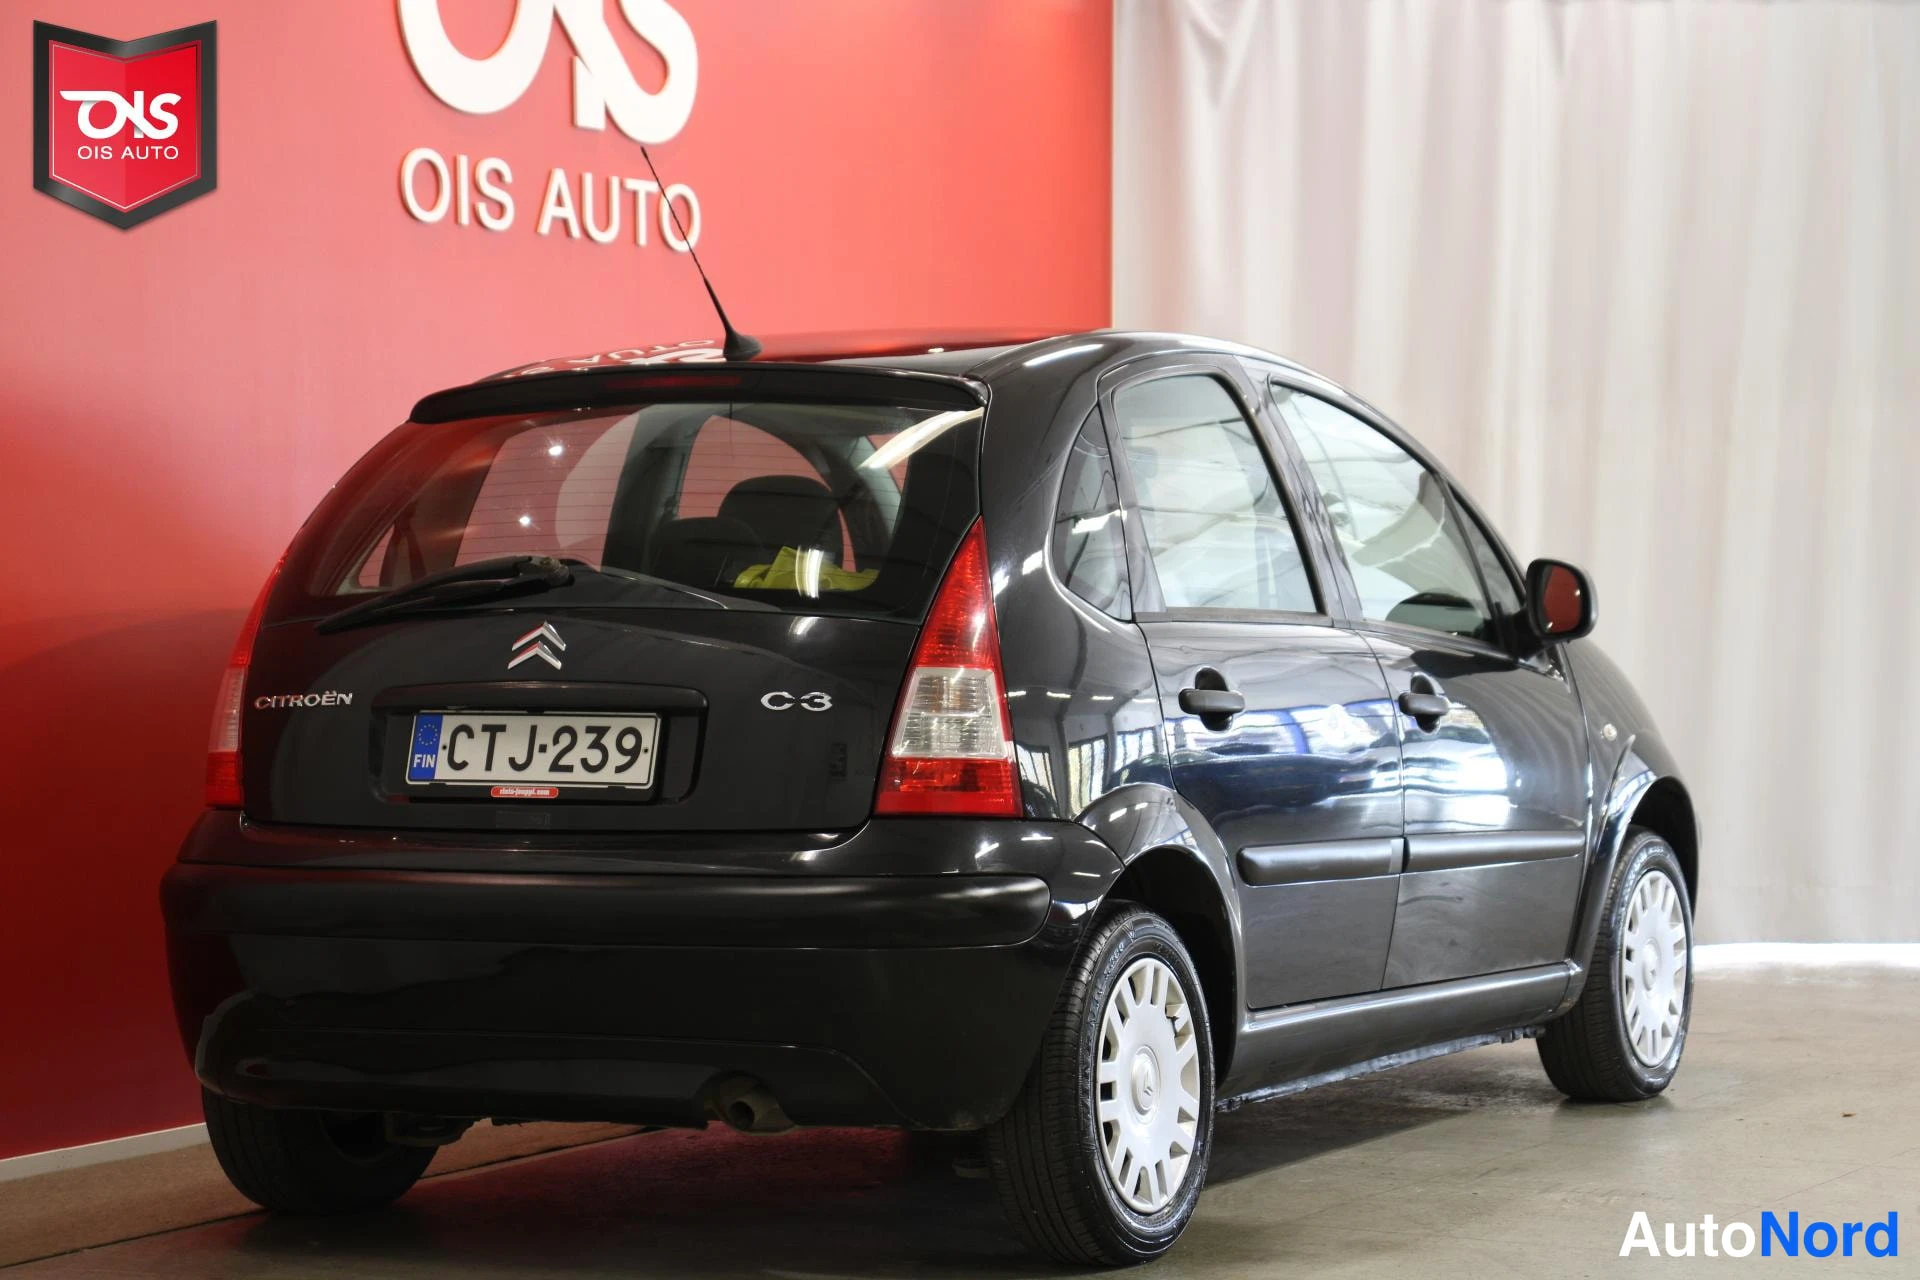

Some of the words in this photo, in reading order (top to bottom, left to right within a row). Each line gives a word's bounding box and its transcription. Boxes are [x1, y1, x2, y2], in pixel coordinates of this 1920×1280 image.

[400, 147, 515, 231] OIS
[537, 167, 702, 252] AUTO
[254, 690, 353, 710] CITROËN
[413, 754, 436, 768] FIN
[446, 724, 643, 774] CTJ-239
